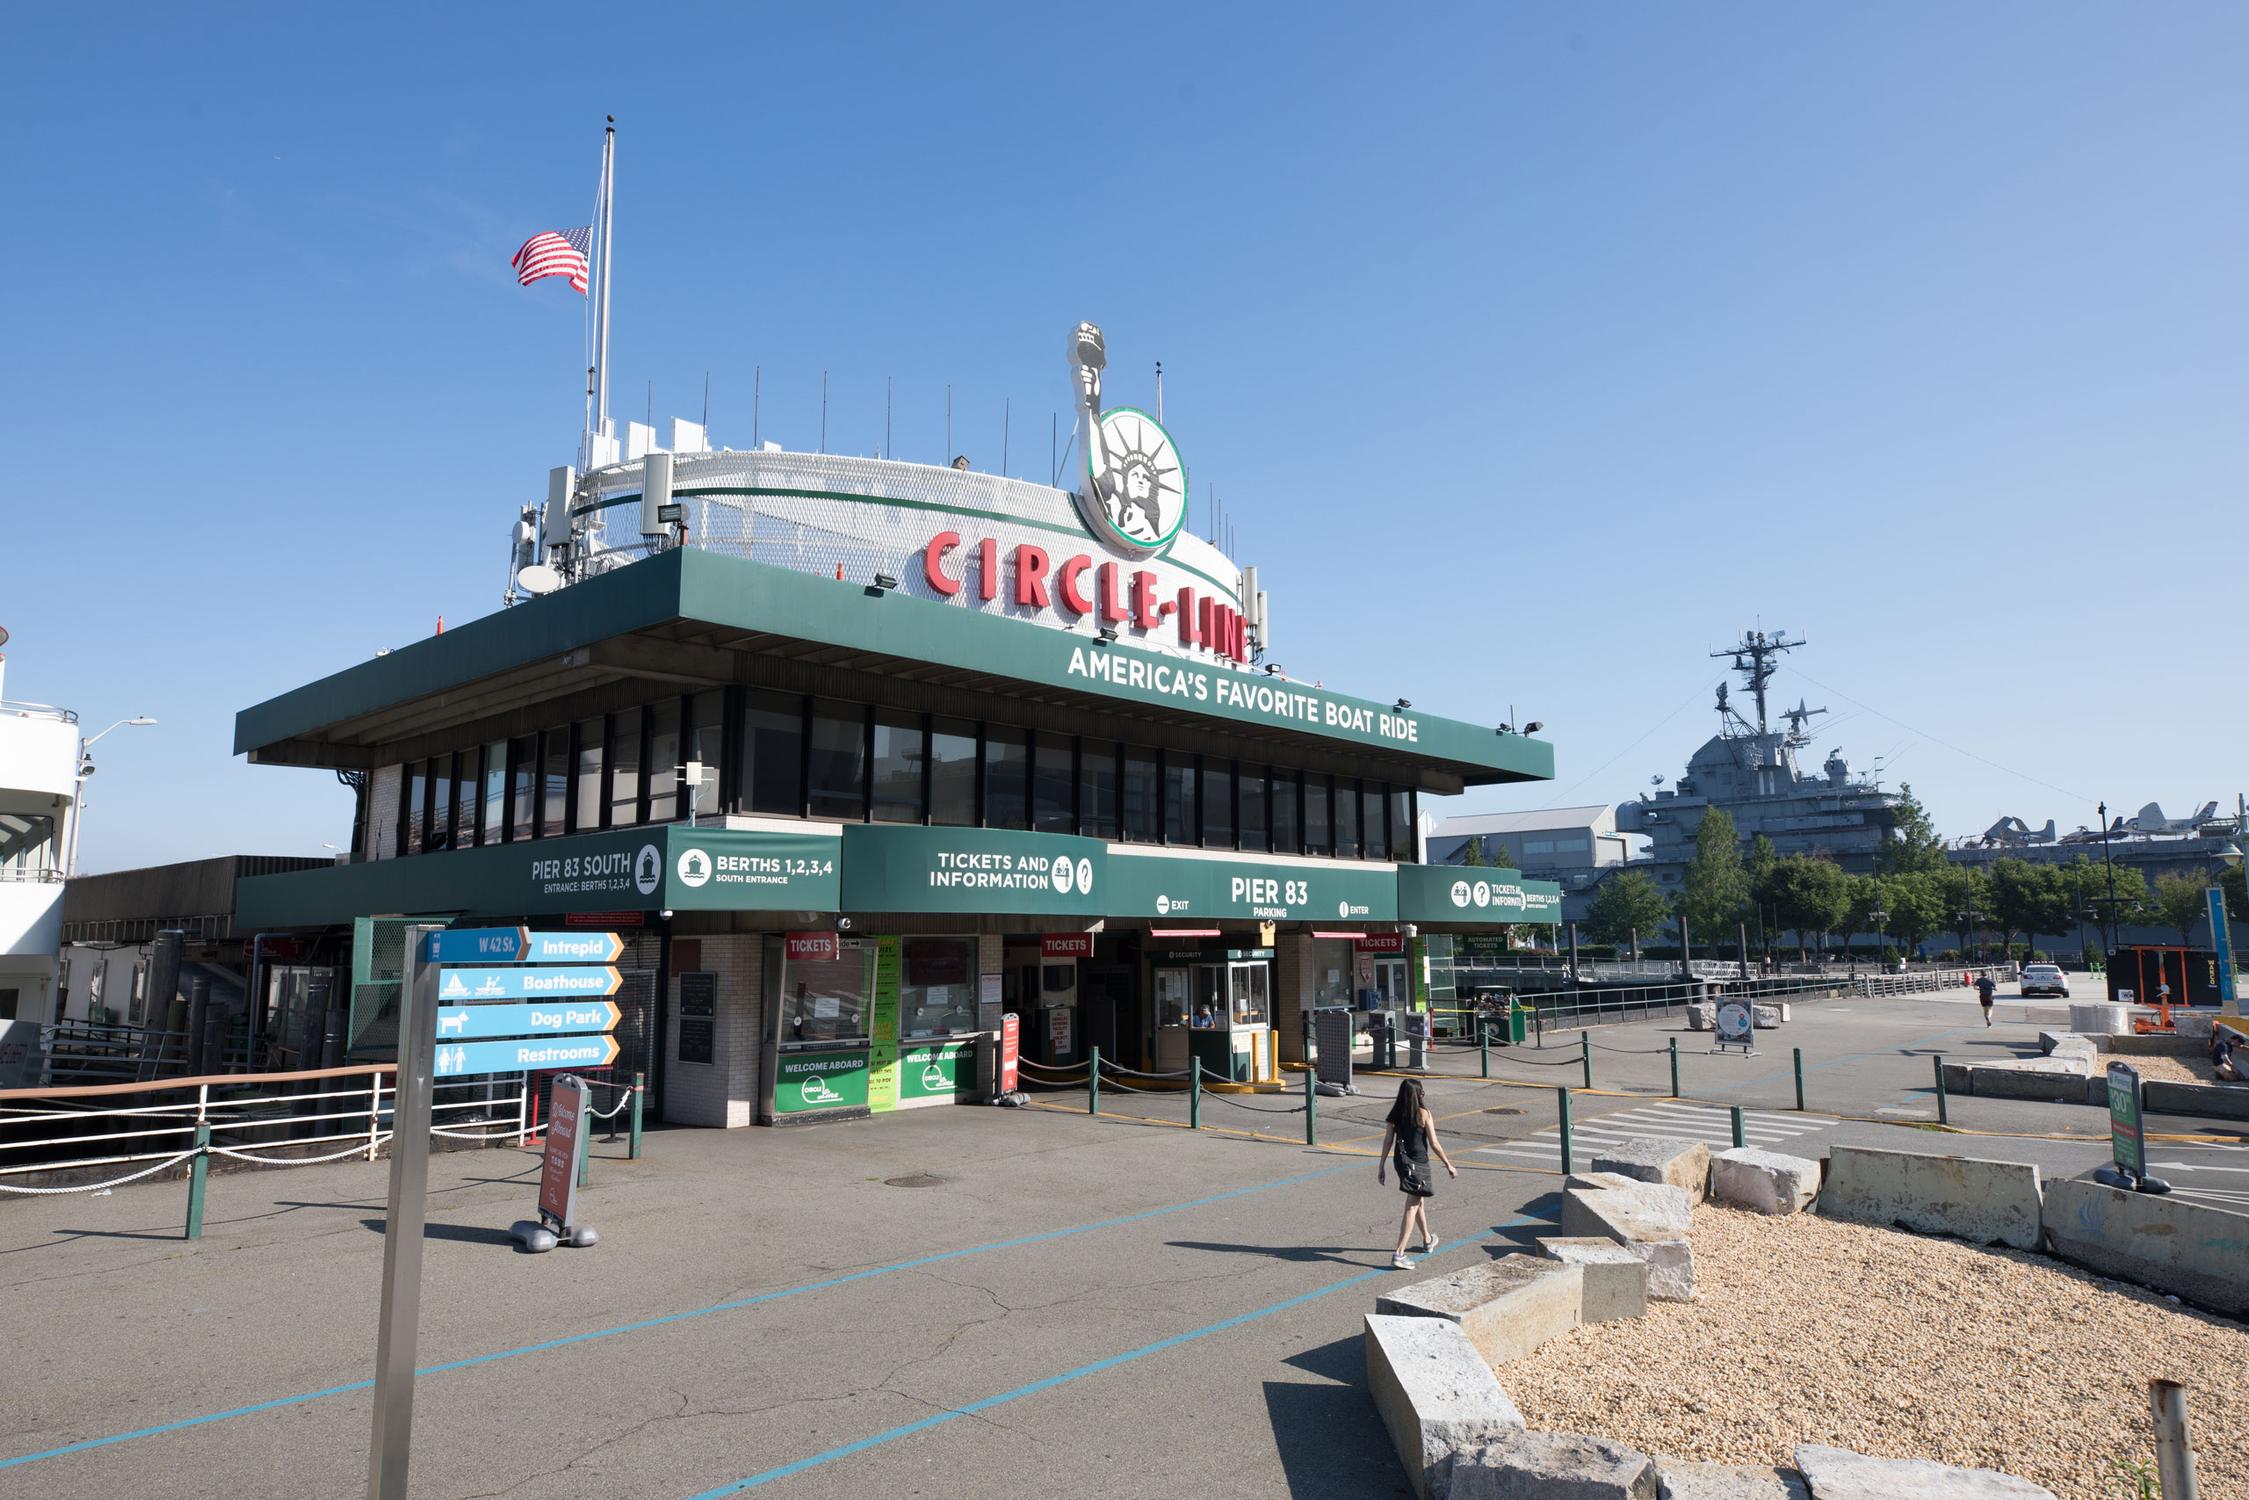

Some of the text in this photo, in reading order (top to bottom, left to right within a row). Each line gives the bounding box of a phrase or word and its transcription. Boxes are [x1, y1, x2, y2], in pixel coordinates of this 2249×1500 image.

[1068, 647, 1418, 743] AMERICA'S FAVORITE BOAT RIDE
[532, 852, 631, 880] PIER 83 SOUTH
[717, 856, 833, 876] BERTHS 1,2,3,4
[938, 852, 1049, 872] TICKETS AND
[544, 881, 580, 894] ENTRANCE:
[581, 880, 607, 891] BERTHS
[716, 874, 788, 885] SOUTH ENTRANCE
[930, 871, 1049, 890] INFORMATION
[1232, 877, 1308, 905] PIER 83
[1171, 900, 1189, 910] EXIT
[1253, 907, 1287, 918] PARKING
[1350, 906, 1369, 915] ENTER
[479, 936, 515, 952] W 42 St.
[543, 939, 603, 957] Intrepid
[790, 938, 832, 952] TICKETS
[1046, 939, 1087, 951] TICKETS
[1360, 938, 1397, 947] TICKETS
[523, 975, 604, 991] Boathouse
[530, 1009, 601, 1028] Dog Park
[517, 1045, 600, 1063] Restrooms
[906, 1050, 973, 1063] WELCOME ABOARD
[785, 1061, 828, 1073] WELCOME
[828, 1059, 864, 1071] ABOARD
